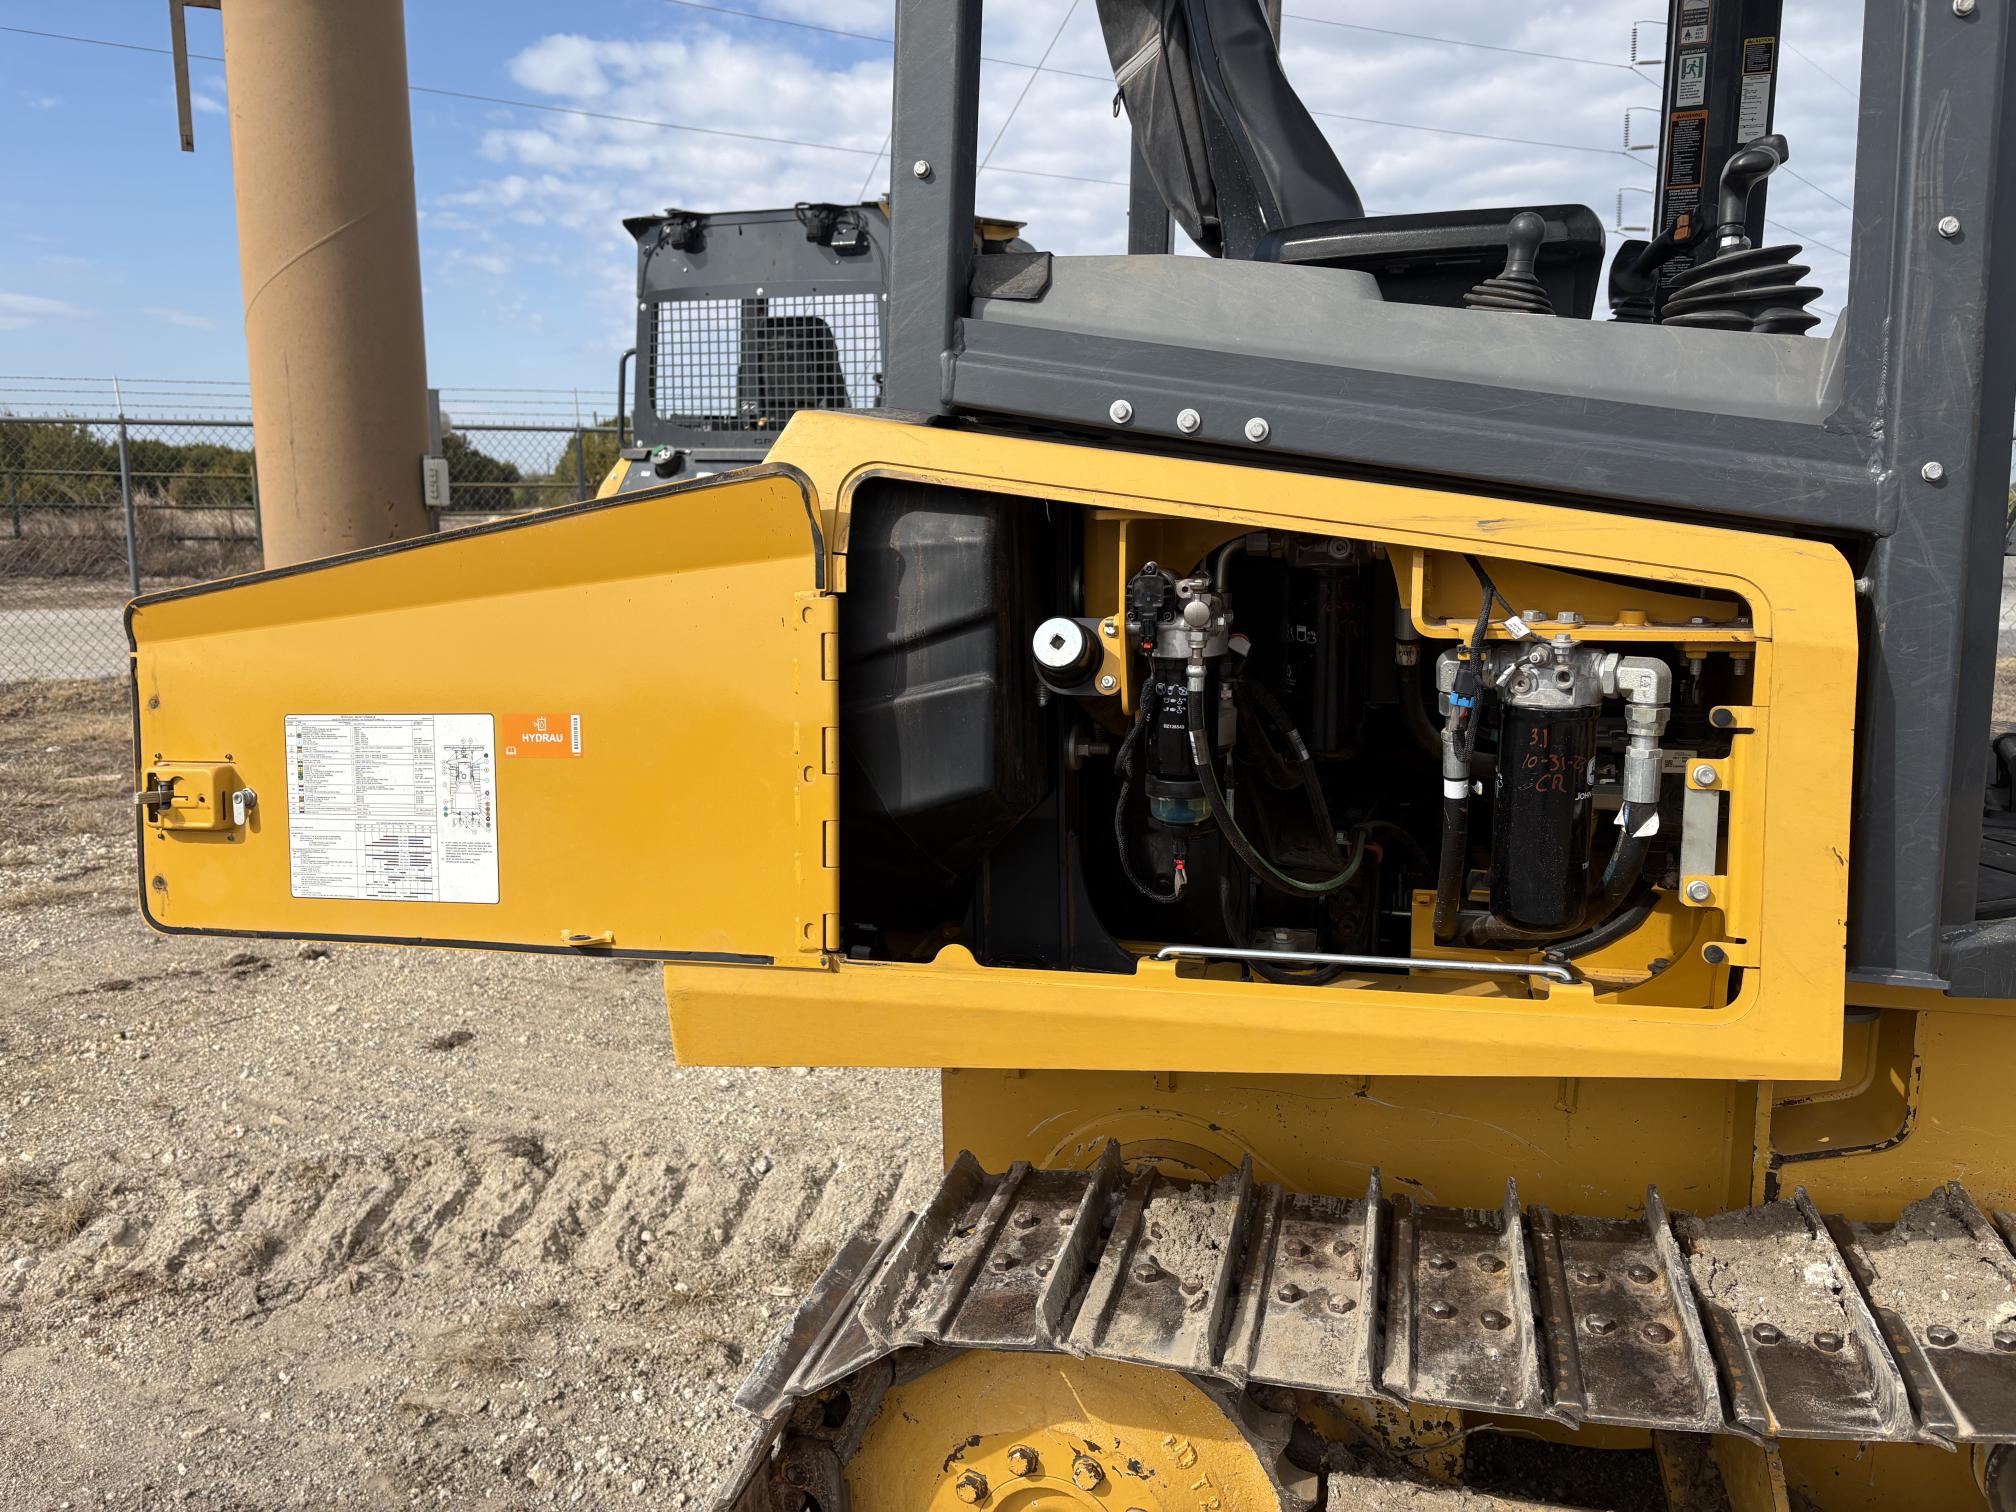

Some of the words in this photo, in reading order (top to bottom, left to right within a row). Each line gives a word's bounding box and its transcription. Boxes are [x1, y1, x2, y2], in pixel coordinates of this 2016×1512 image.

[522, 733, 563, 743] HYDRAU
[1535, 773, 1567, 793] CR
[1574, 791, 1592, 801] JOHN
